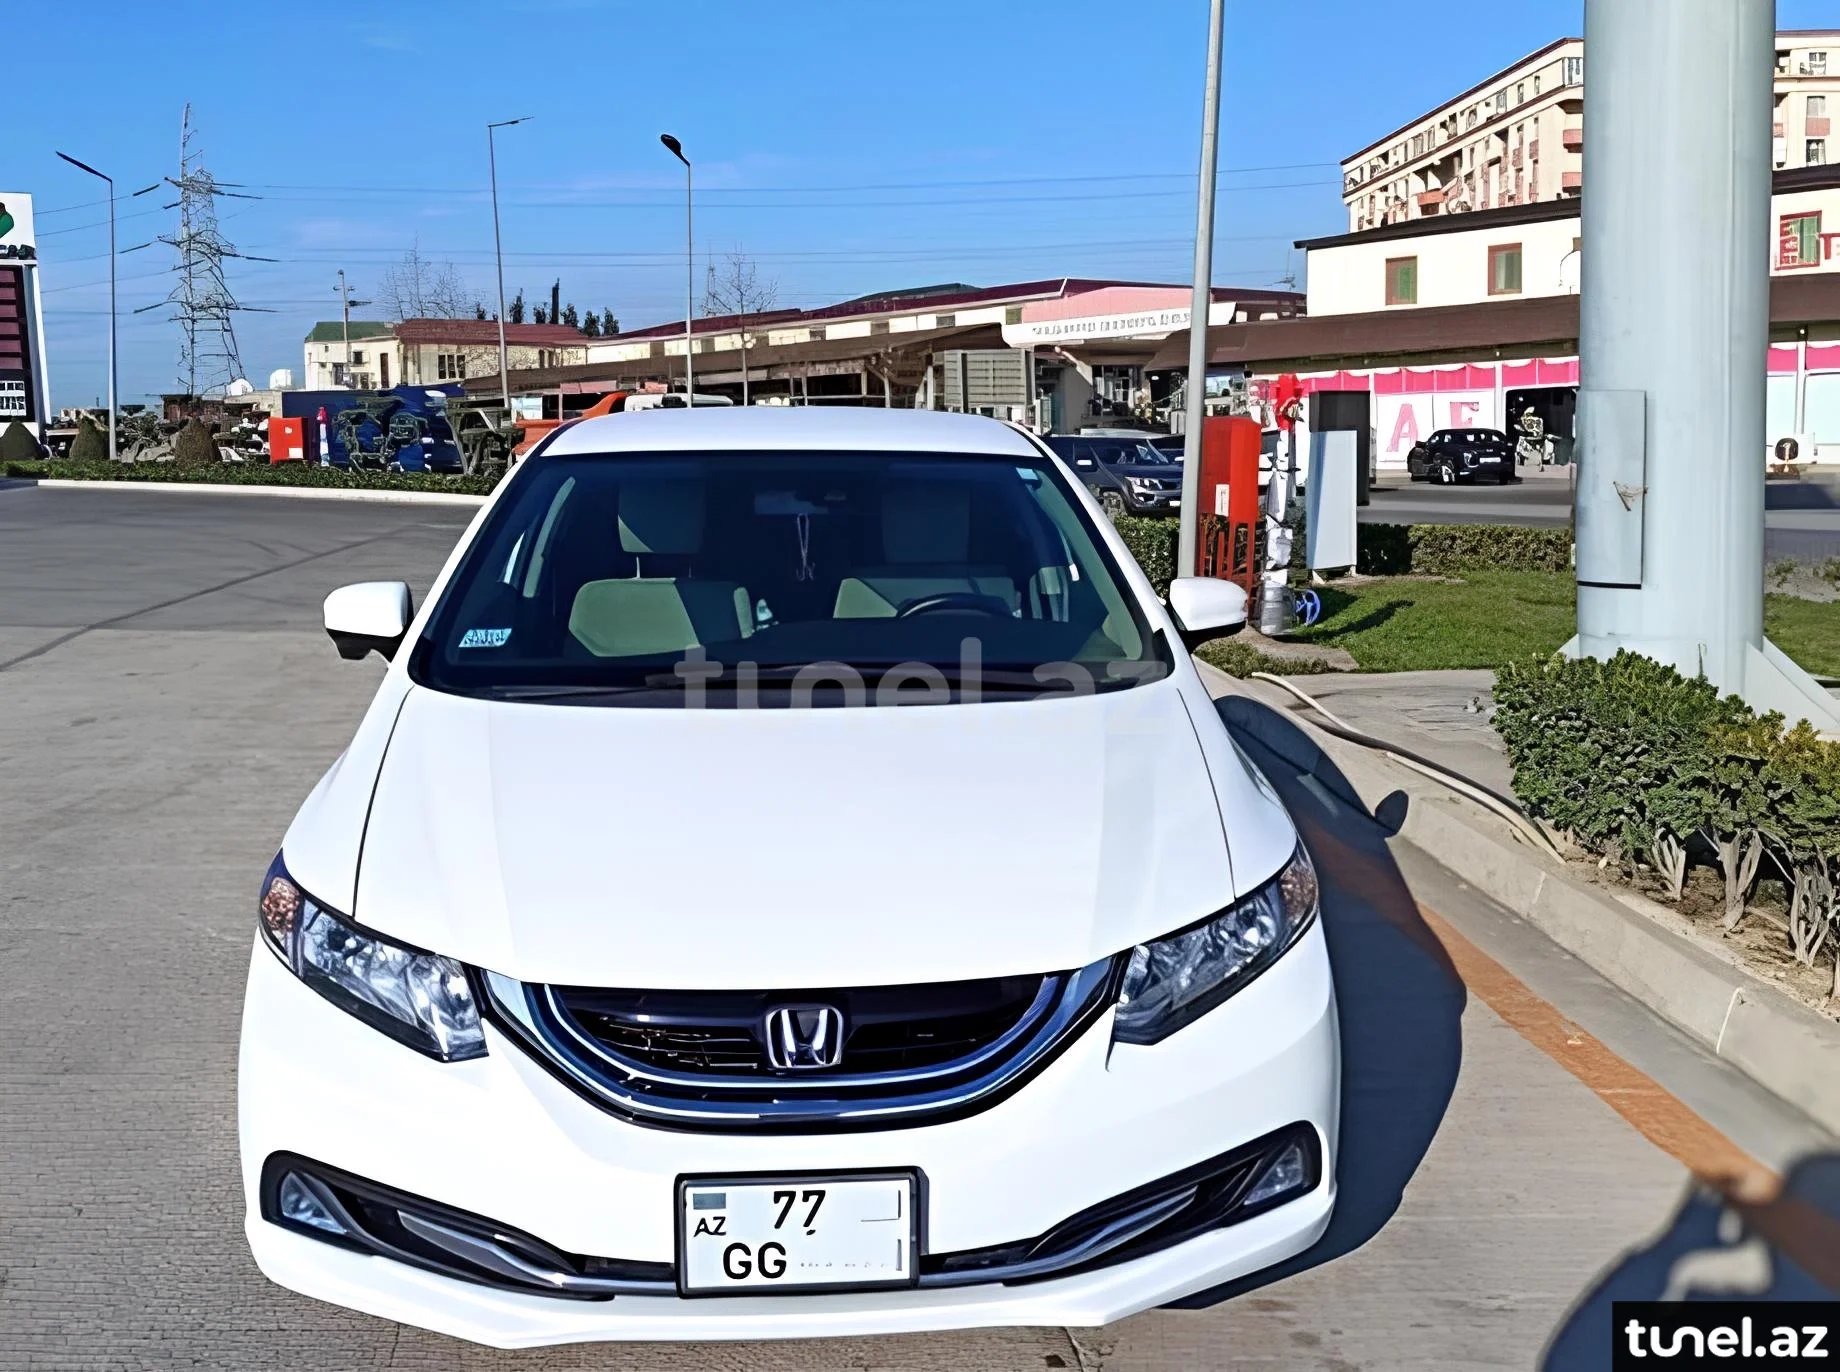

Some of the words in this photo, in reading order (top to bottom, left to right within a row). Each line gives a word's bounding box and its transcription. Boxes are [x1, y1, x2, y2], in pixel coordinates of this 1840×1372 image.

[693, 1216, 727, 1237] AZ
[773, 1190, 826, 1230] 77
[723, 1242, 787, 1280] GG
